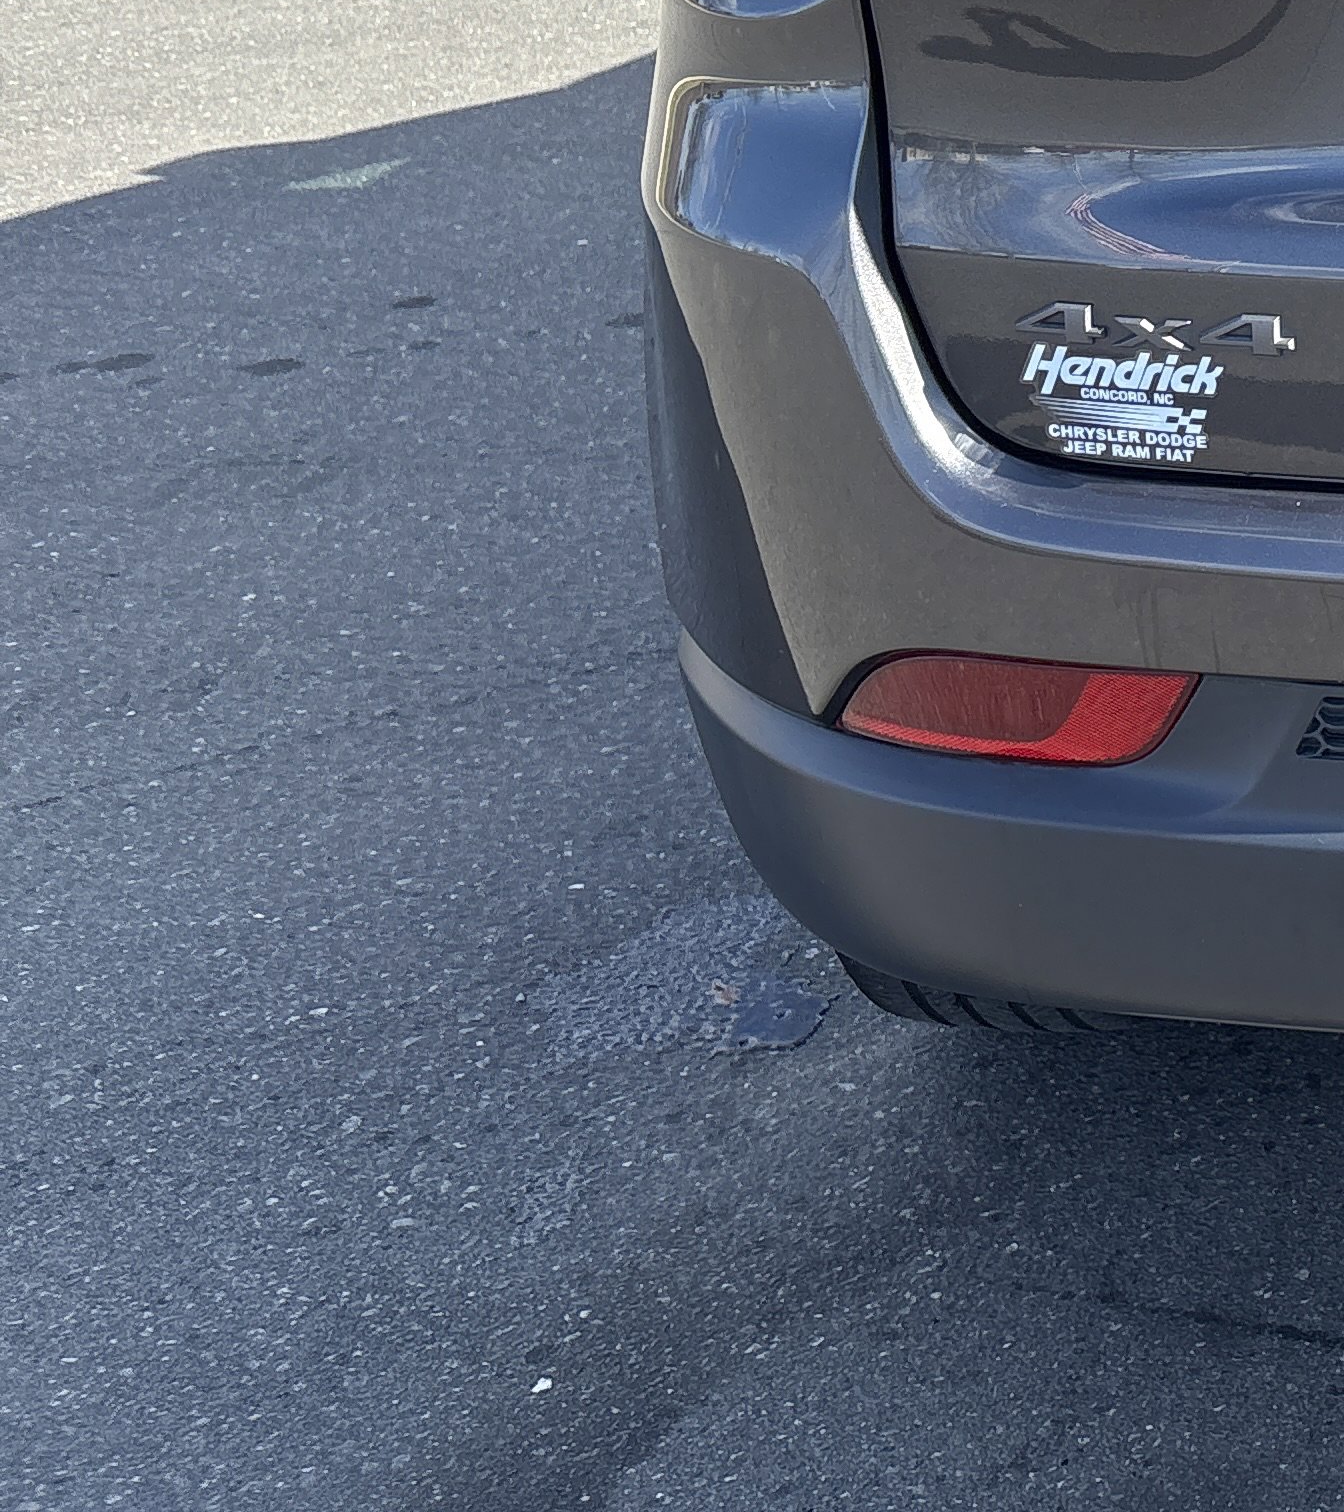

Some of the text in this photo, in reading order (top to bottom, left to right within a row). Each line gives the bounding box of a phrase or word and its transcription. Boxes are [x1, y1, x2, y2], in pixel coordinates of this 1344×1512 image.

[1022, 343, 1224, 395] Hendrick
[1080, 387, 1174, 405] CONCORD, NC
[1049, 423, 1208, 449] CHRYSLER DODGE
[1063, 440, 1195, 462] JEEP RAM FIAT
